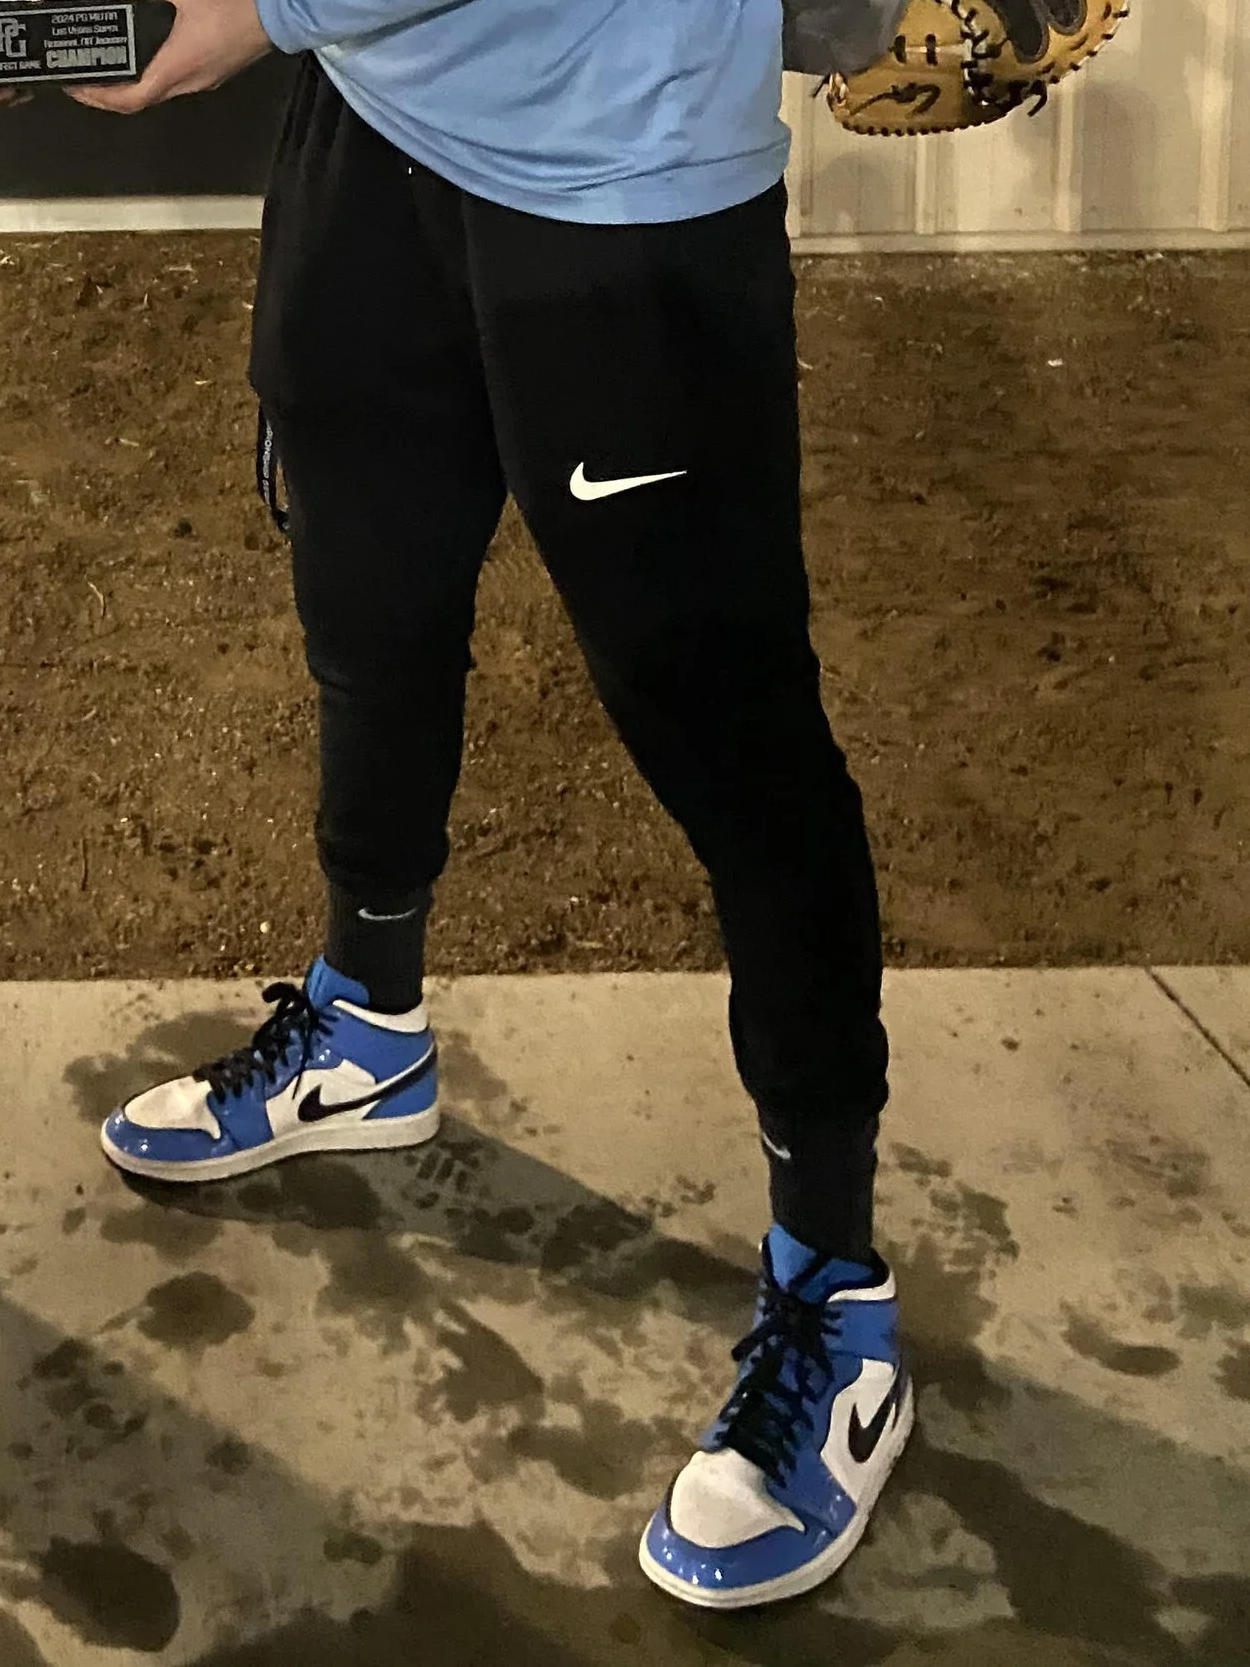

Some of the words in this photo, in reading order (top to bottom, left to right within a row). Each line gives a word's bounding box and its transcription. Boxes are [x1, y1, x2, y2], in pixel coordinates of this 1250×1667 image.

[52, 14, 74, 24] 2024
[75, 13, 88, 23] PG
[46, 46, 127, 68] CHAMPION
[19, 61, 41, 69] GAME
